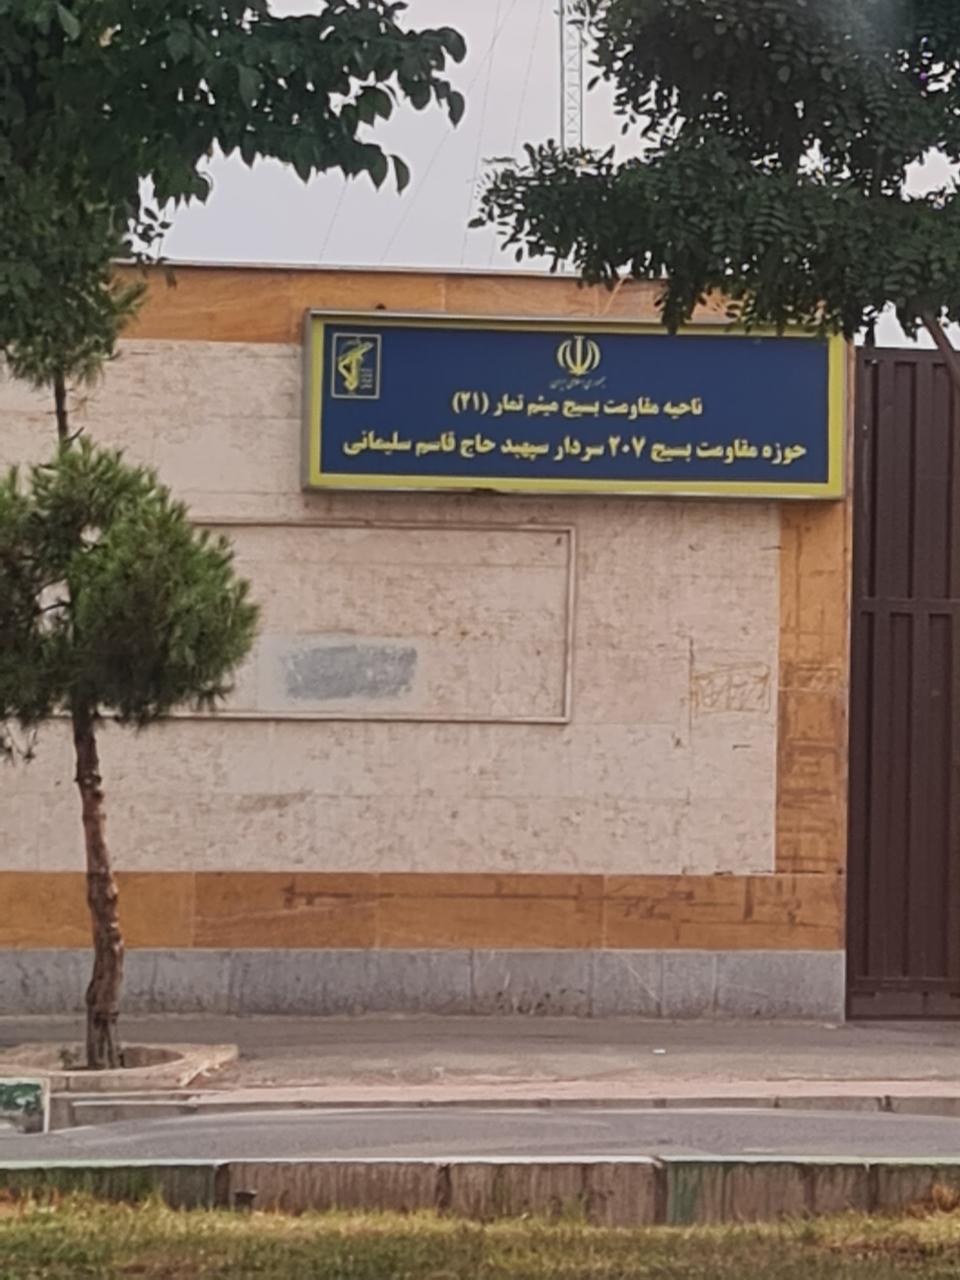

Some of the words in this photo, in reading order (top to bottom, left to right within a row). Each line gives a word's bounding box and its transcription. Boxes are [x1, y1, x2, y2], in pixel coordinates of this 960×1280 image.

[493, 393, 524, 417] تمار
[562, 399, 600, 418] بسیج
[603, 397, 659, 420] مقاومت
[663, 397, 703, 419] ناحیه
[343, 431, 412, 455] سلیمانی
[415, 431, 456, 457] قاسم
[460, 433, 496, 458] حاج
[501, 439, 550, 461] سپهبد
[553, 435, 604, 461] سردار
[608, 435, 646, 458] ۲۰۷
[651, 441, 692, 463] بسیج
[696, 439, 758, 464] مقاومت
[761, 443, 807, 465] حوزه
